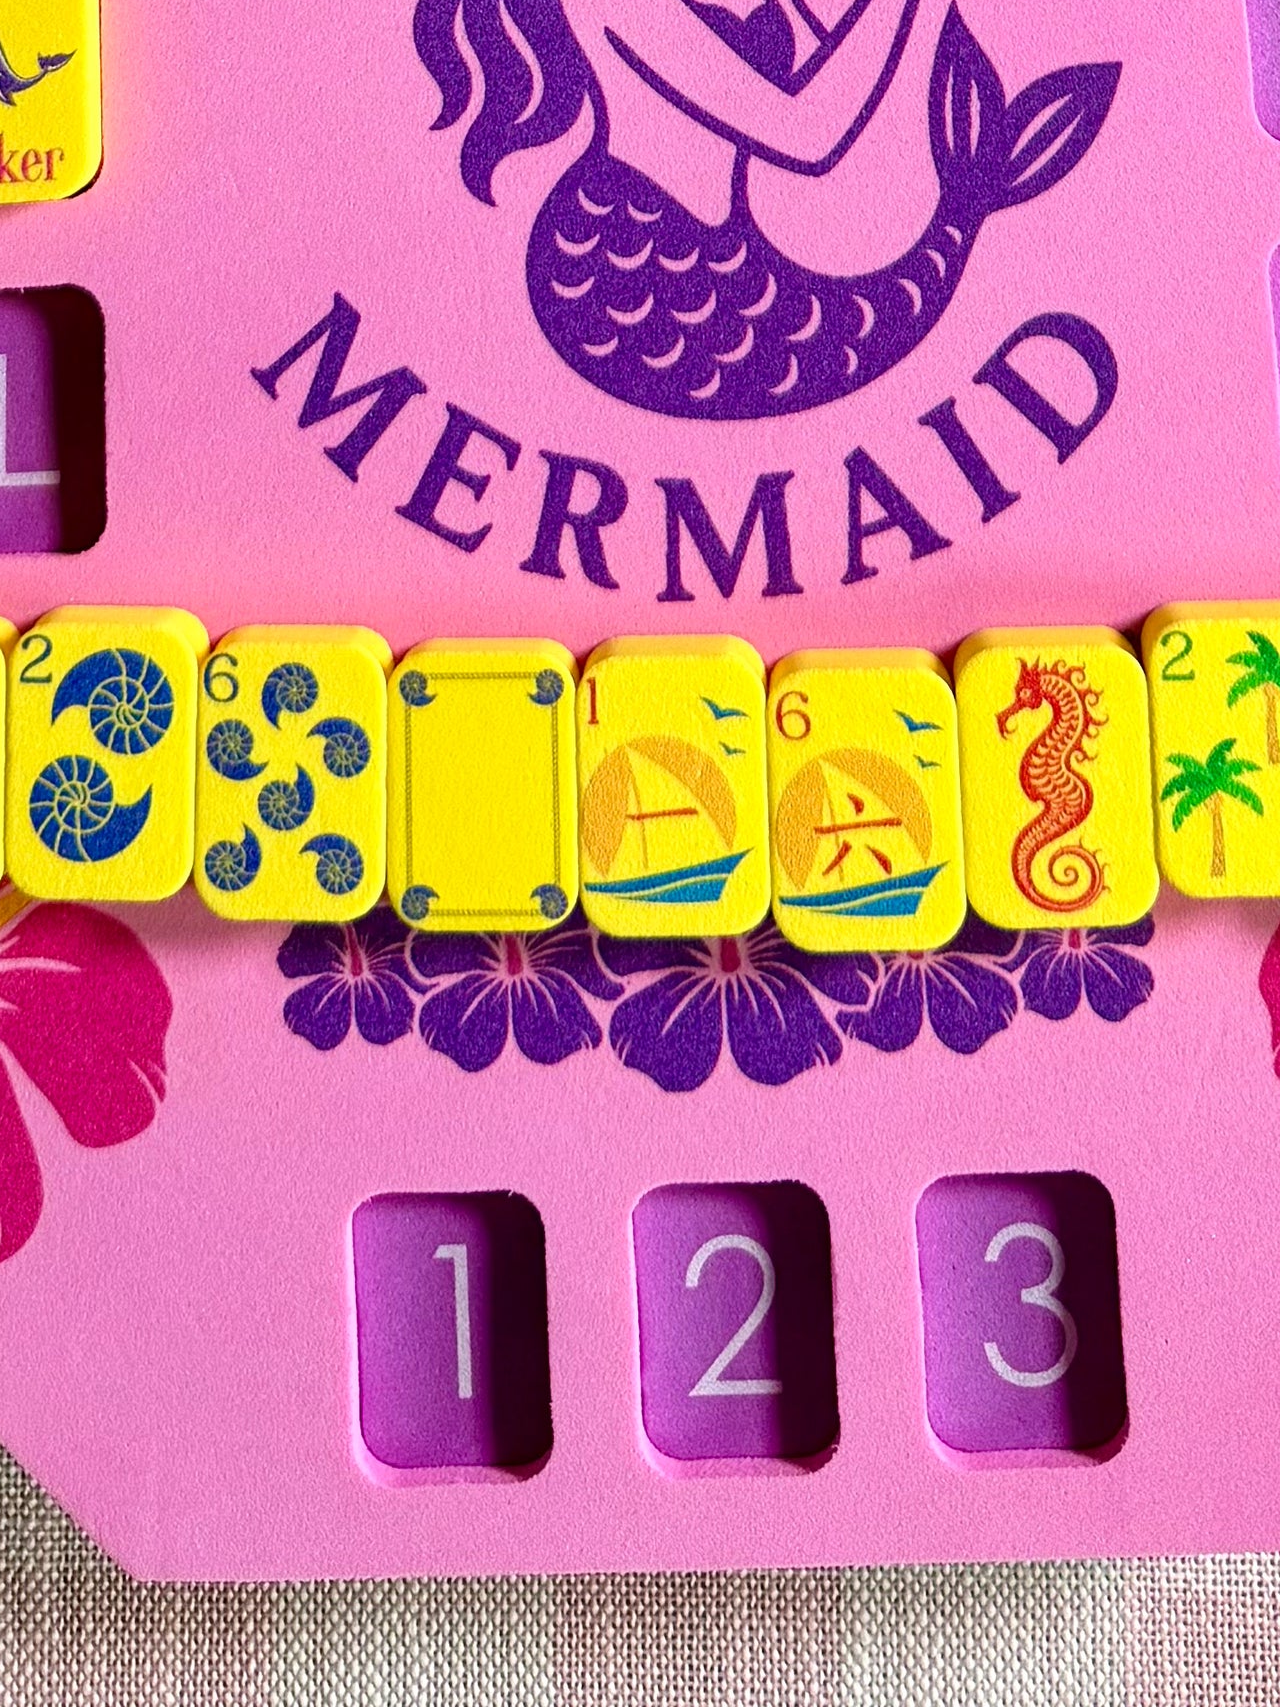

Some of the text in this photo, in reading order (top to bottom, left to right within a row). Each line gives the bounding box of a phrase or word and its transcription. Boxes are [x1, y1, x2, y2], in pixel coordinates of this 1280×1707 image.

[250, 291, 1119, 602] MERMAID
[19, 635, 54, 685] 2
[203, 653, 240, 703] 6
[1160, 631, 1196, 681] 2
[585, 678, 600, 726] 1
[775, 691, 812, 741] 6
[814, 792, 903, 876] 六
[432, 1222, 1078, 1399] 1 2 3
